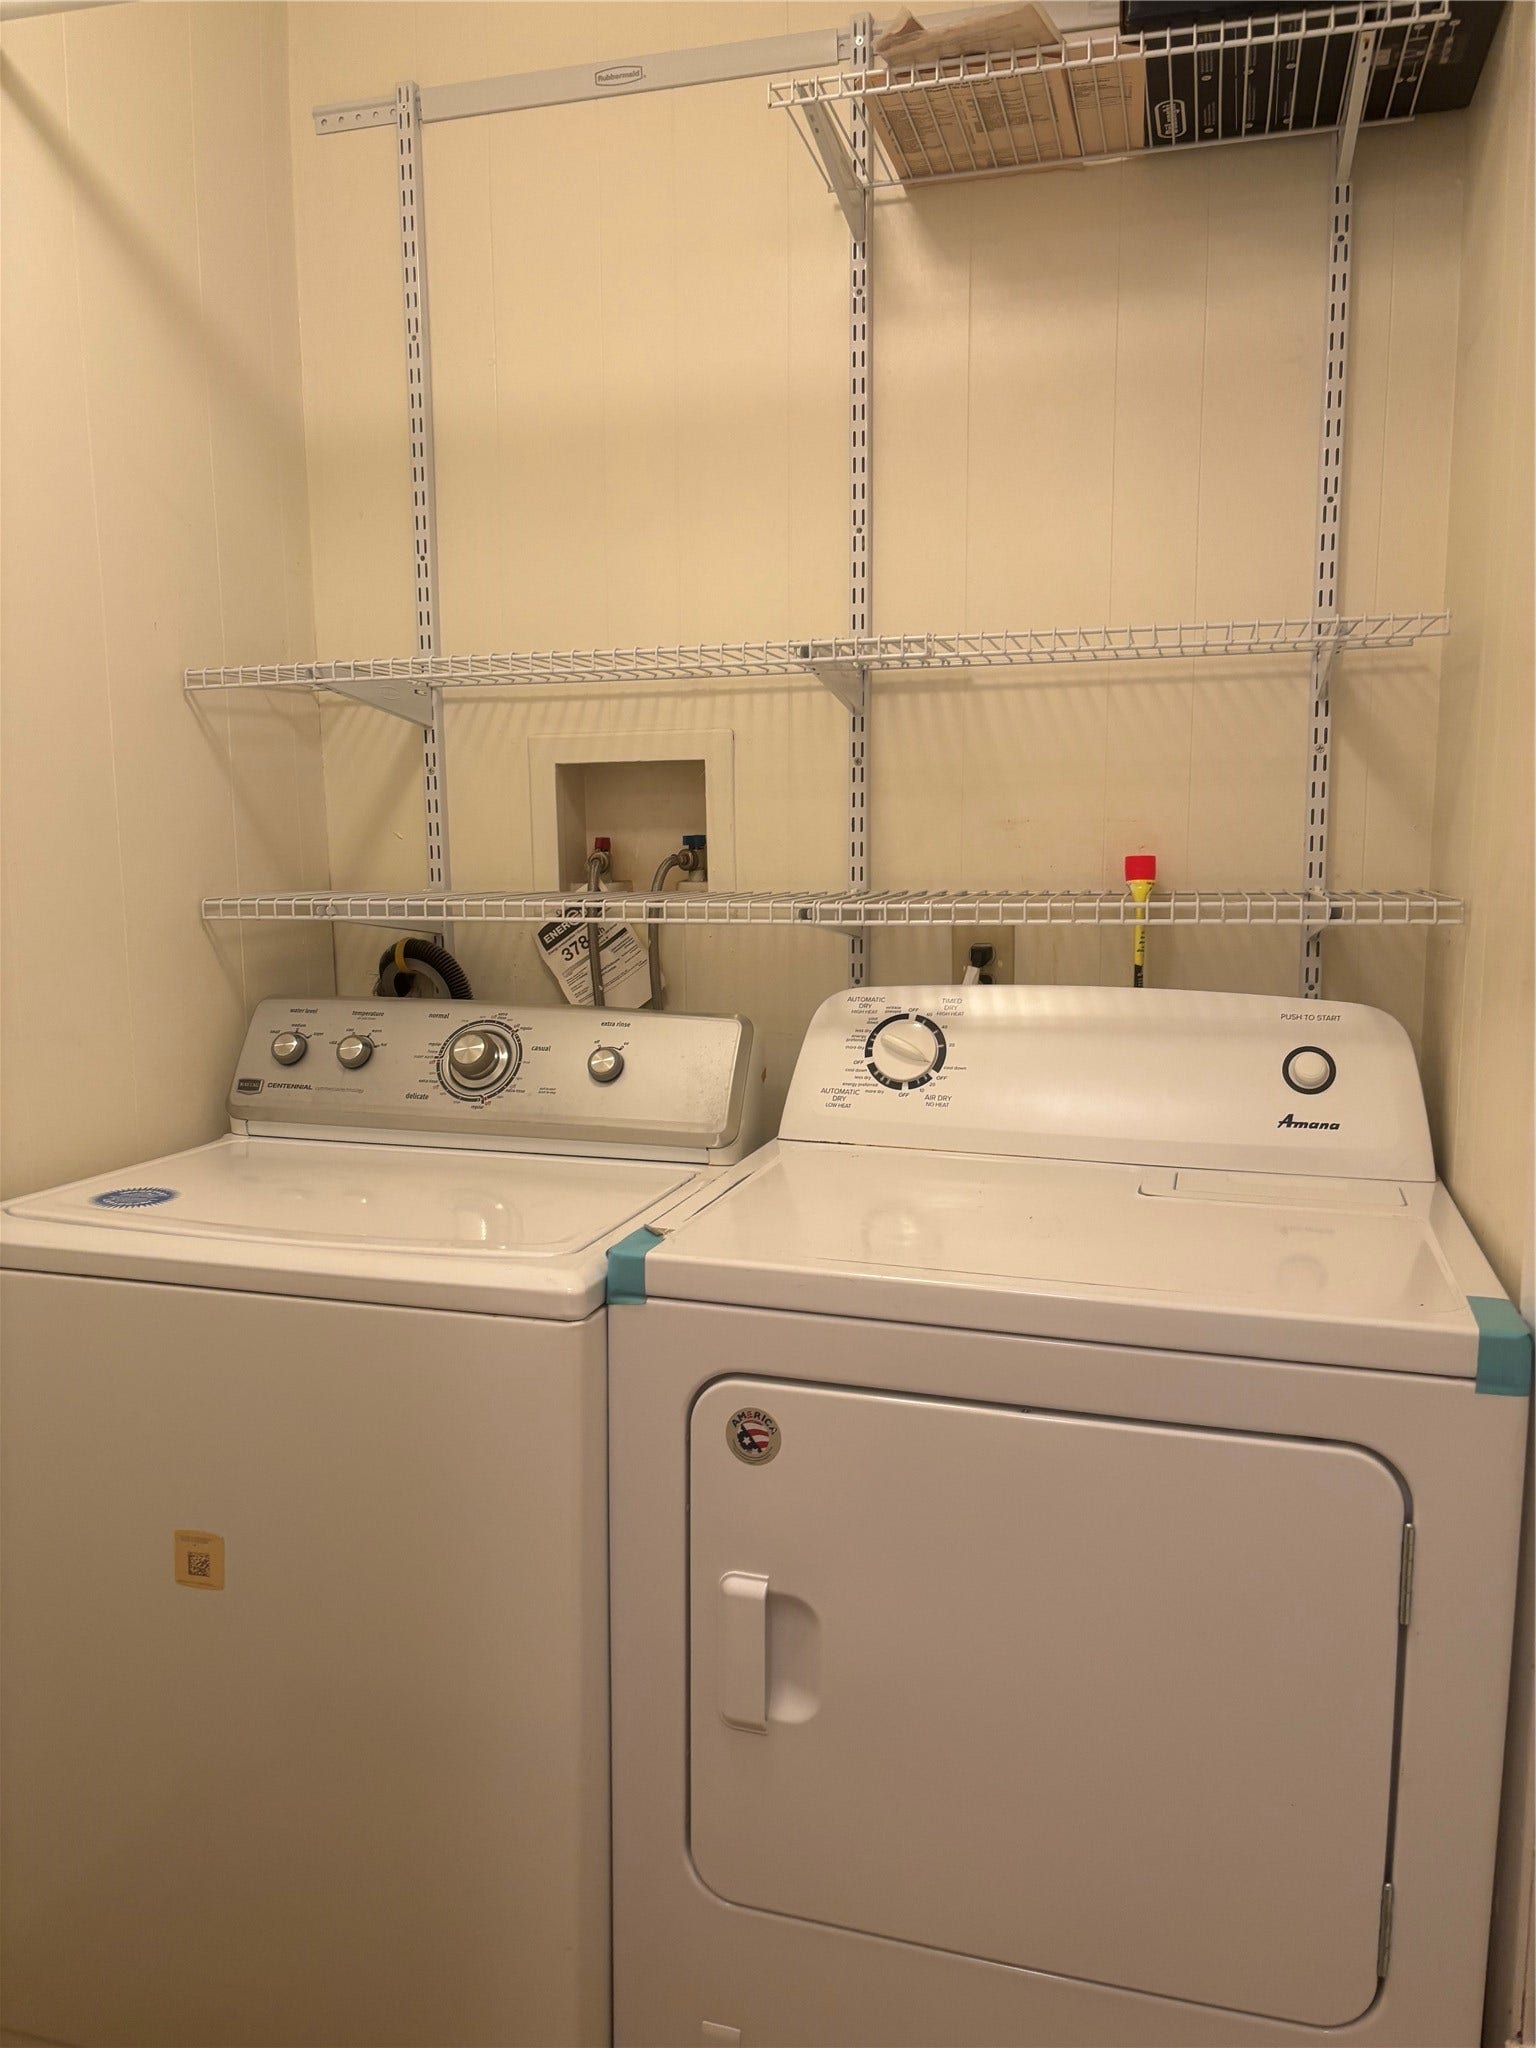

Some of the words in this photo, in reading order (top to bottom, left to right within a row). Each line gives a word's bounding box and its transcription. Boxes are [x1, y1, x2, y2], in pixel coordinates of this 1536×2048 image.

[561, 935, 590, 961] 378
[267, 1082, 313, 1091] CENTENNIAL
[1277, 1113, 1340, 1130] Amana
[732, 1411, 778, 1435] AMERICA
